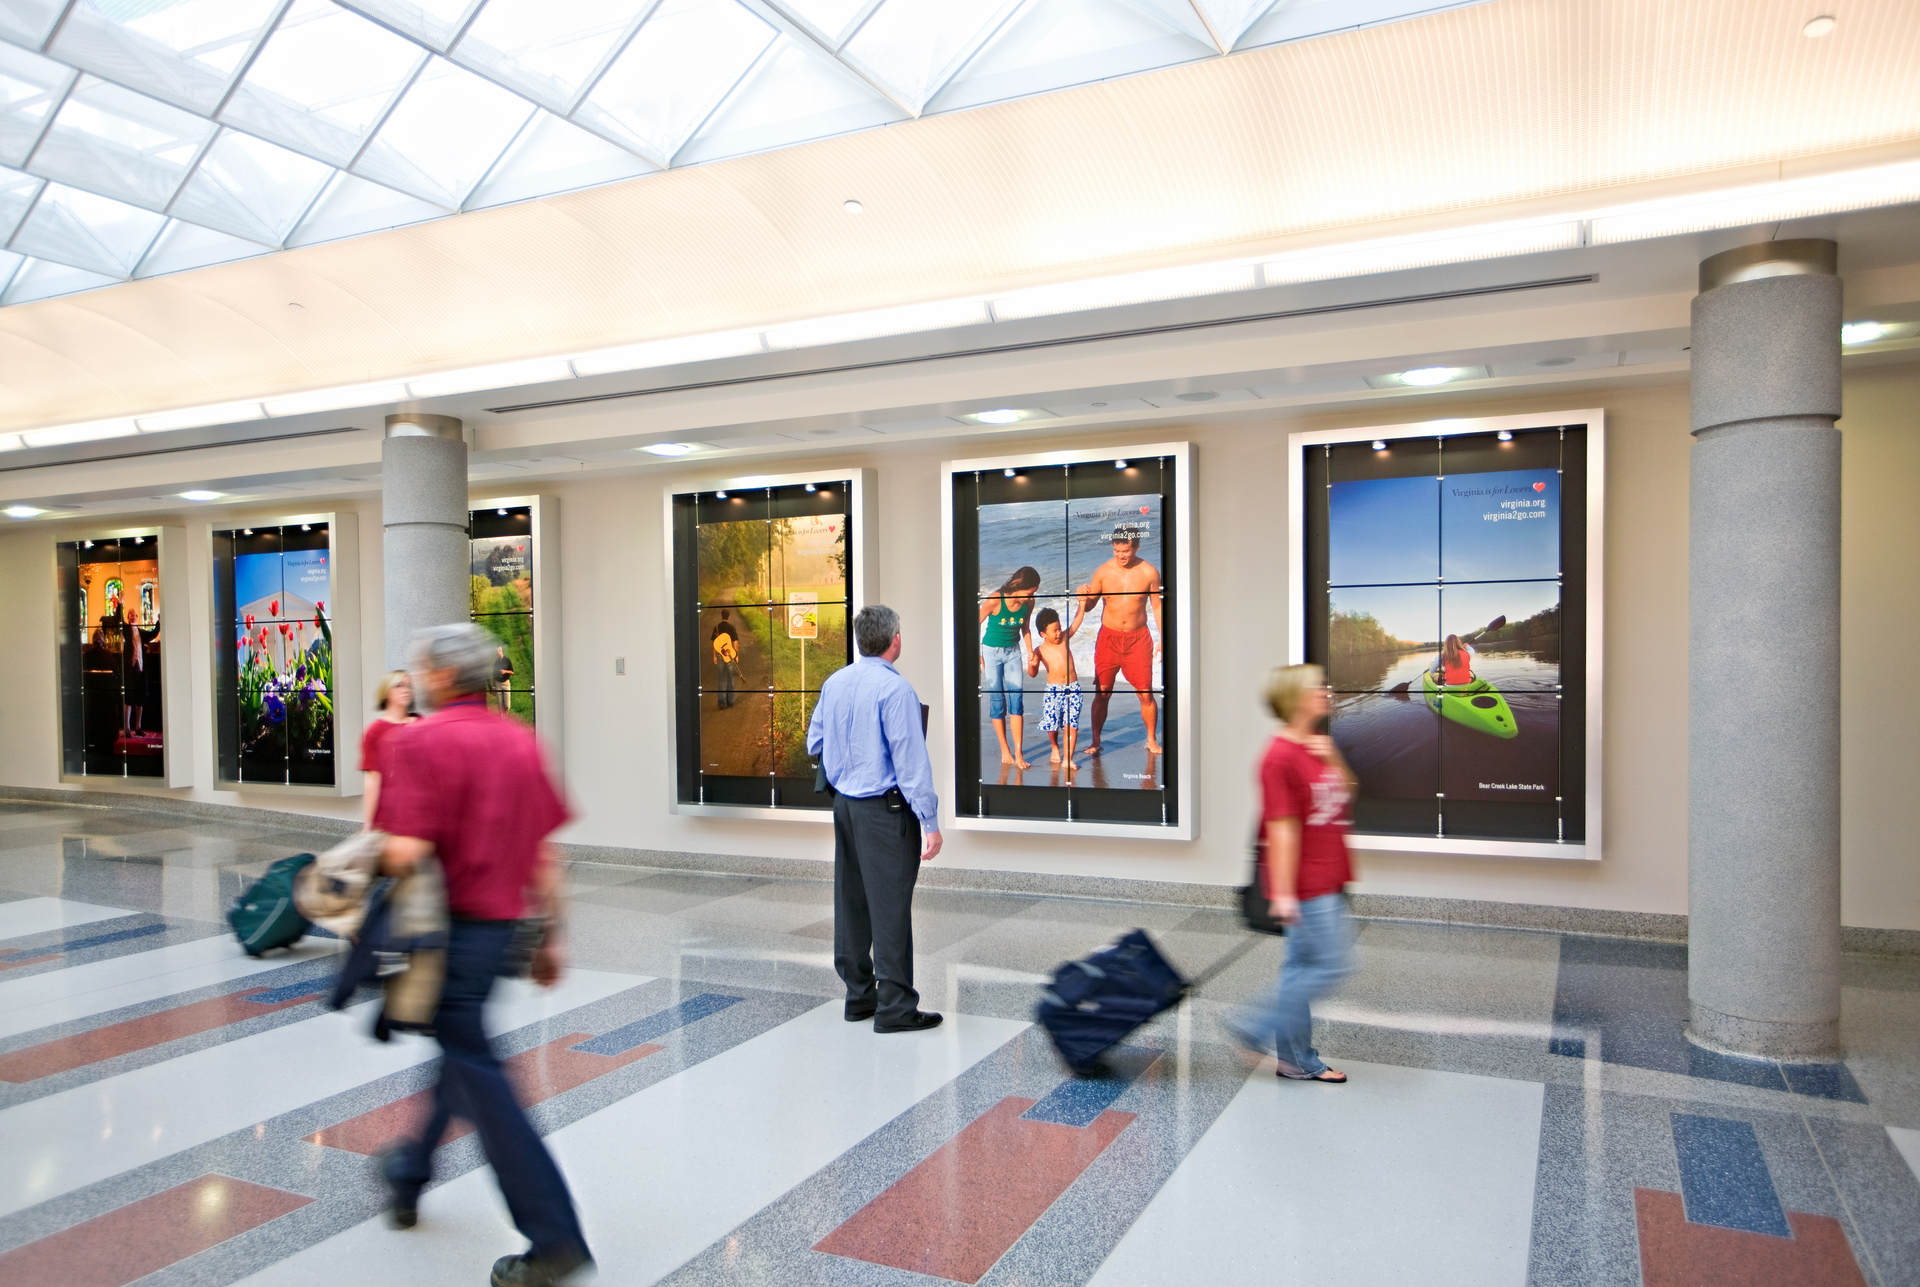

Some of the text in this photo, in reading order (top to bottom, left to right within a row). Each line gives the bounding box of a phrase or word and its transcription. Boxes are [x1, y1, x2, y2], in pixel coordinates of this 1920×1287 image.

[1452, 485, 1533, 498] Virginia is for Lovers
[1500, 499, 1546, 510] virginia.org
[1076, 511, 1101, 519] Virginia
[1117, 508, 1141, 517] Lovers
[1483, 510, 1546, 522] virginia2go.com
[1114, 521, 1150, 530] virginia.org
[1100, 531, 1150, 540] virginia2go.com
